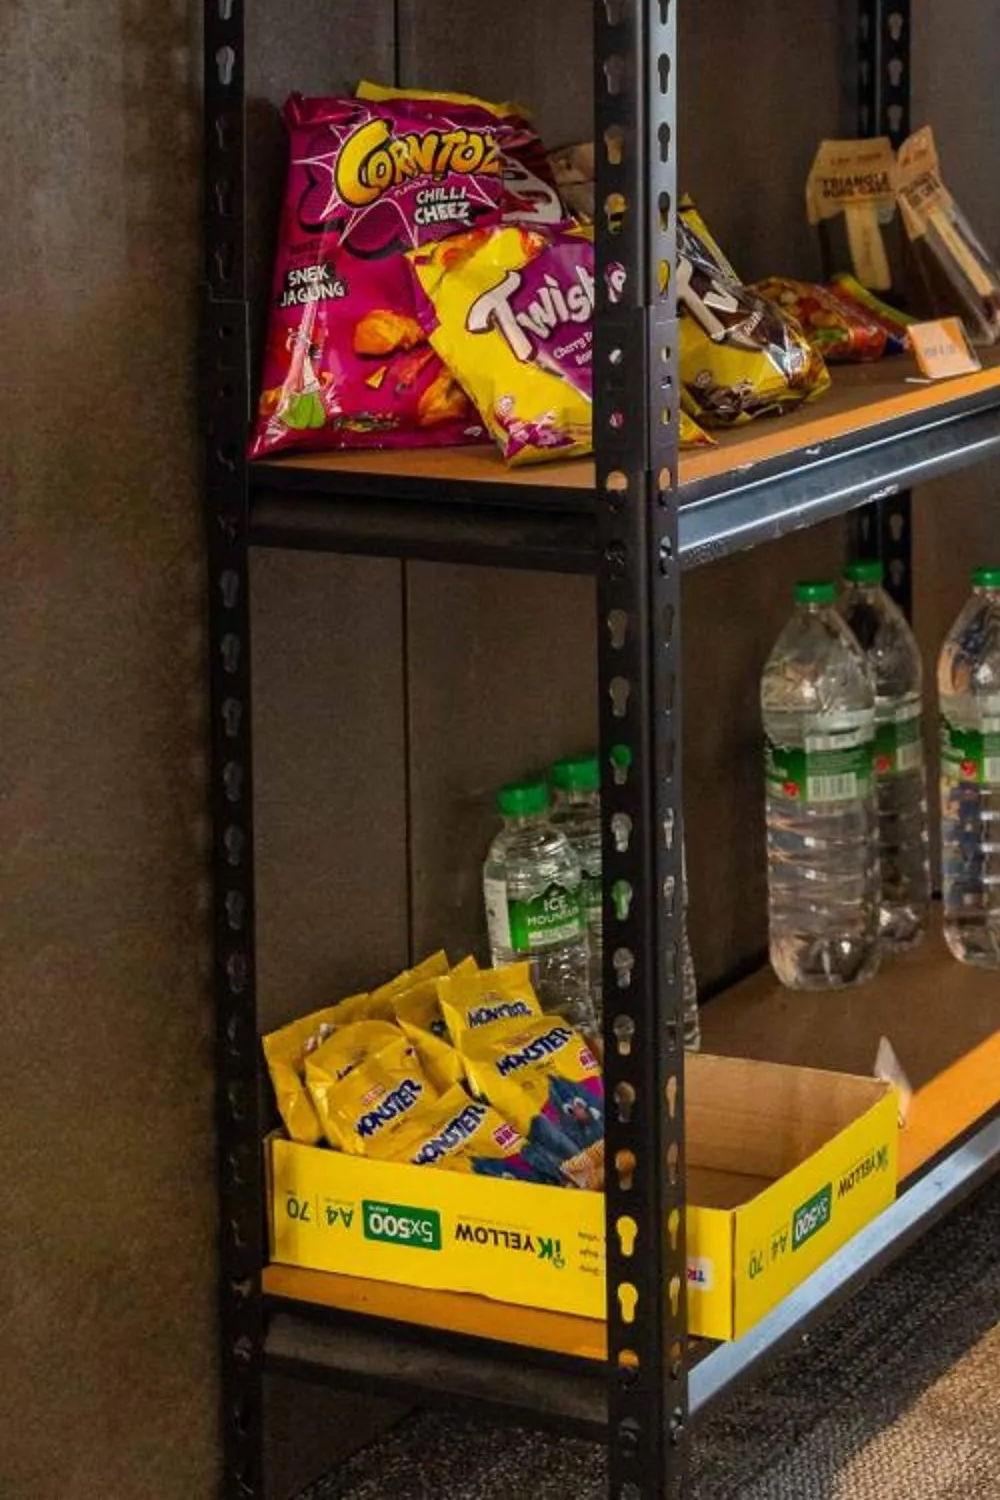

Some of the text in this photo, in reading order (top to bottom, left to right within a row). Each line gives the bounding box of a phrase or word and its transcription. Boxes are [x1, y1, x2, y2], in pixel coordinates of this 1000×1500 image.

[416, 185, 467, 205] CHILLI
[414, 201, 470, 225] CHEEZ
[287, 263, 330, 287] SNEK
[280, 281, 346, 308] JAGUNG
[287, 1198, 310, 1221] 70
[326, 1204, 354, 1228] A4
[369, 1212, 433, 1243] 5x500
[455, 1222, 535, 1253] YELLOW
